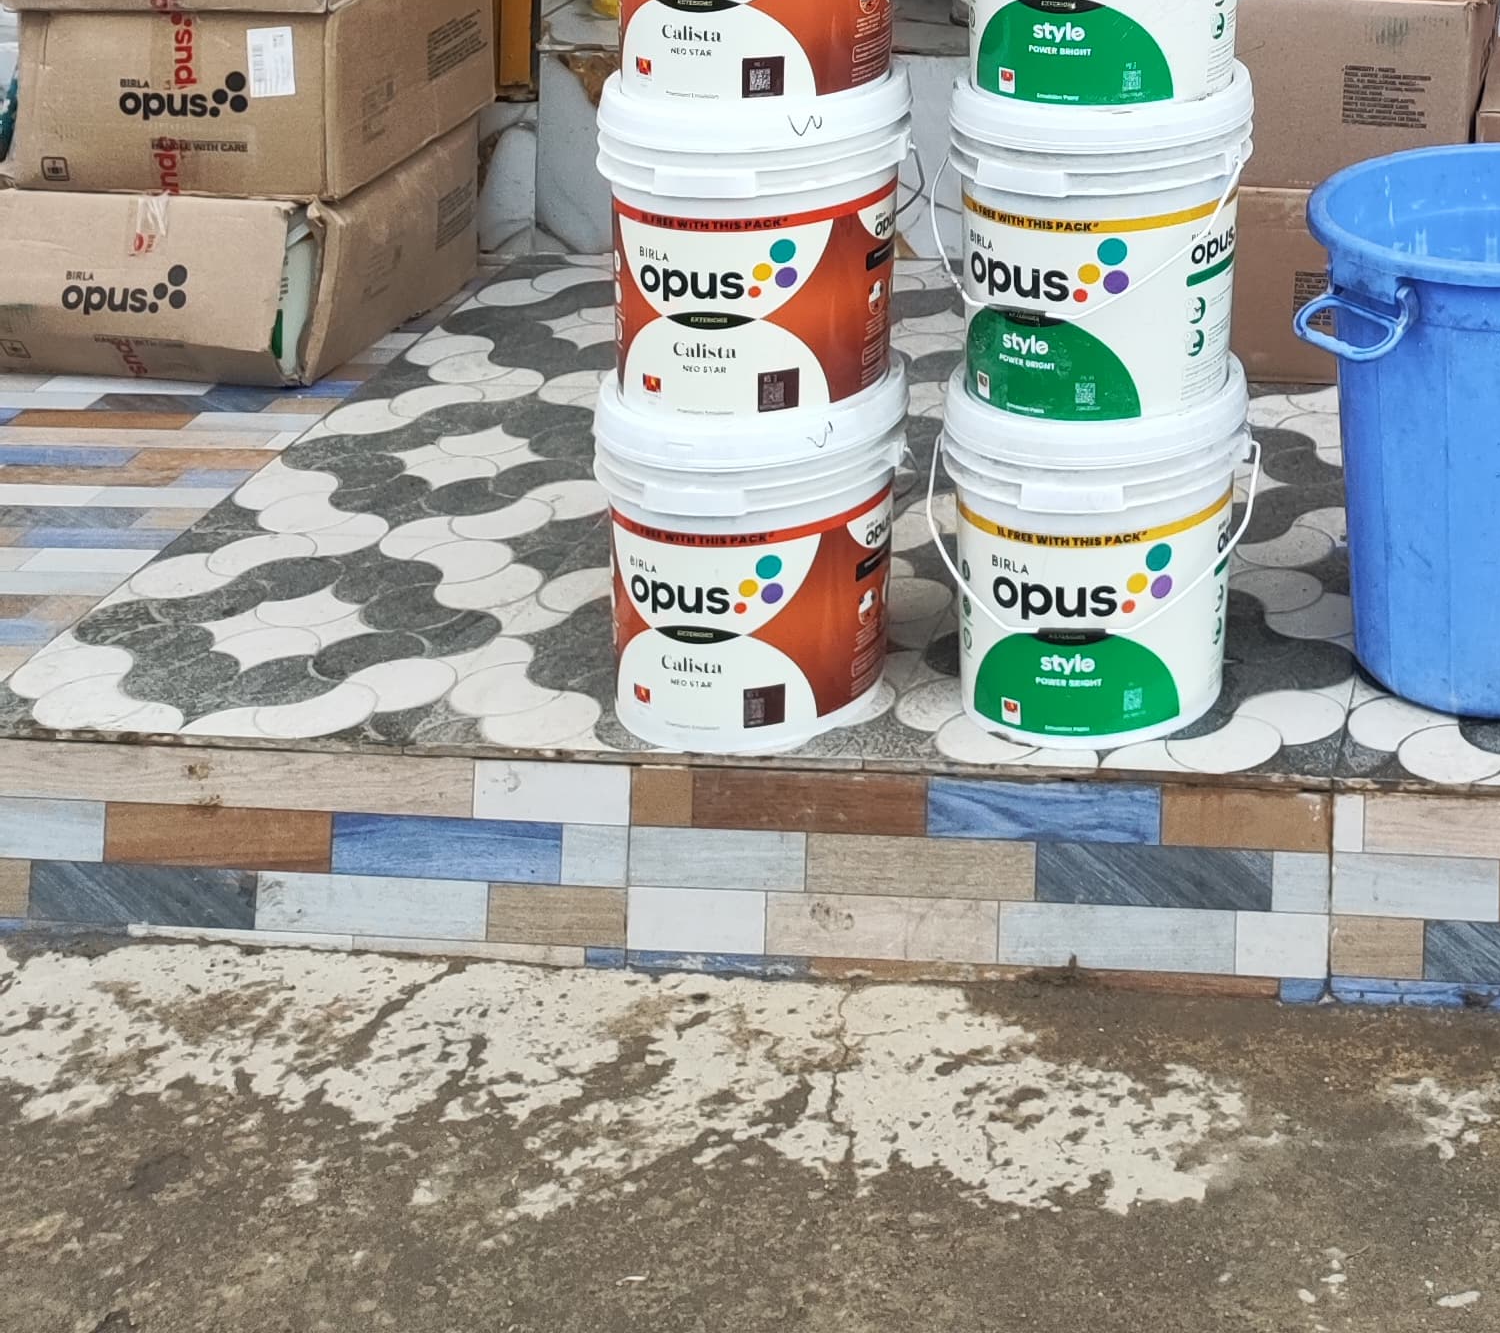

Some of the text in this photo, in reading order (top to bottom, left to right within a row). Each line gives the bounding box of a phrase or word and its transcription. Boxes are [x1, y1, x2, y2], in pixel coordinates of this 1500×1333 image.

[662, 25, 721, 43] Calista
[1033, 22, 1085, 43] style
[1029, 45, 1092, 56] POWER BRIGHT
[120, 79, 149, 88] BIRLA
[119, 90, 209, 120] opus
[221, 143, 248, 152] CARE
[677, 219, 741, 230] WITH THIS
[1027, 219, 1053, 230] THIS
[970, 229, 993, 252] BIRLA
[640, 246, 669, 262] BIRLA
[66, 271, 94, 281] BIRLA
[640, 264, 745, 302] opus
[971, 251, 1069, 302] opus
[62, 285, 148, 315] opus
[673, 341, 736, 359] Calista
[1003, 332, 1049, 355] style
[1007, 528, 1102, 547] FREE WITH THIS
[630, 555, 657, 573] BIRLA
[992, 554, 1029, 575] BIRLA
[631, 574, 730, 615] opus
[993, 576, 1118, 620] opus
[662, 654, 722, 675] Calista
[1040, 654, 1095, 675] style
